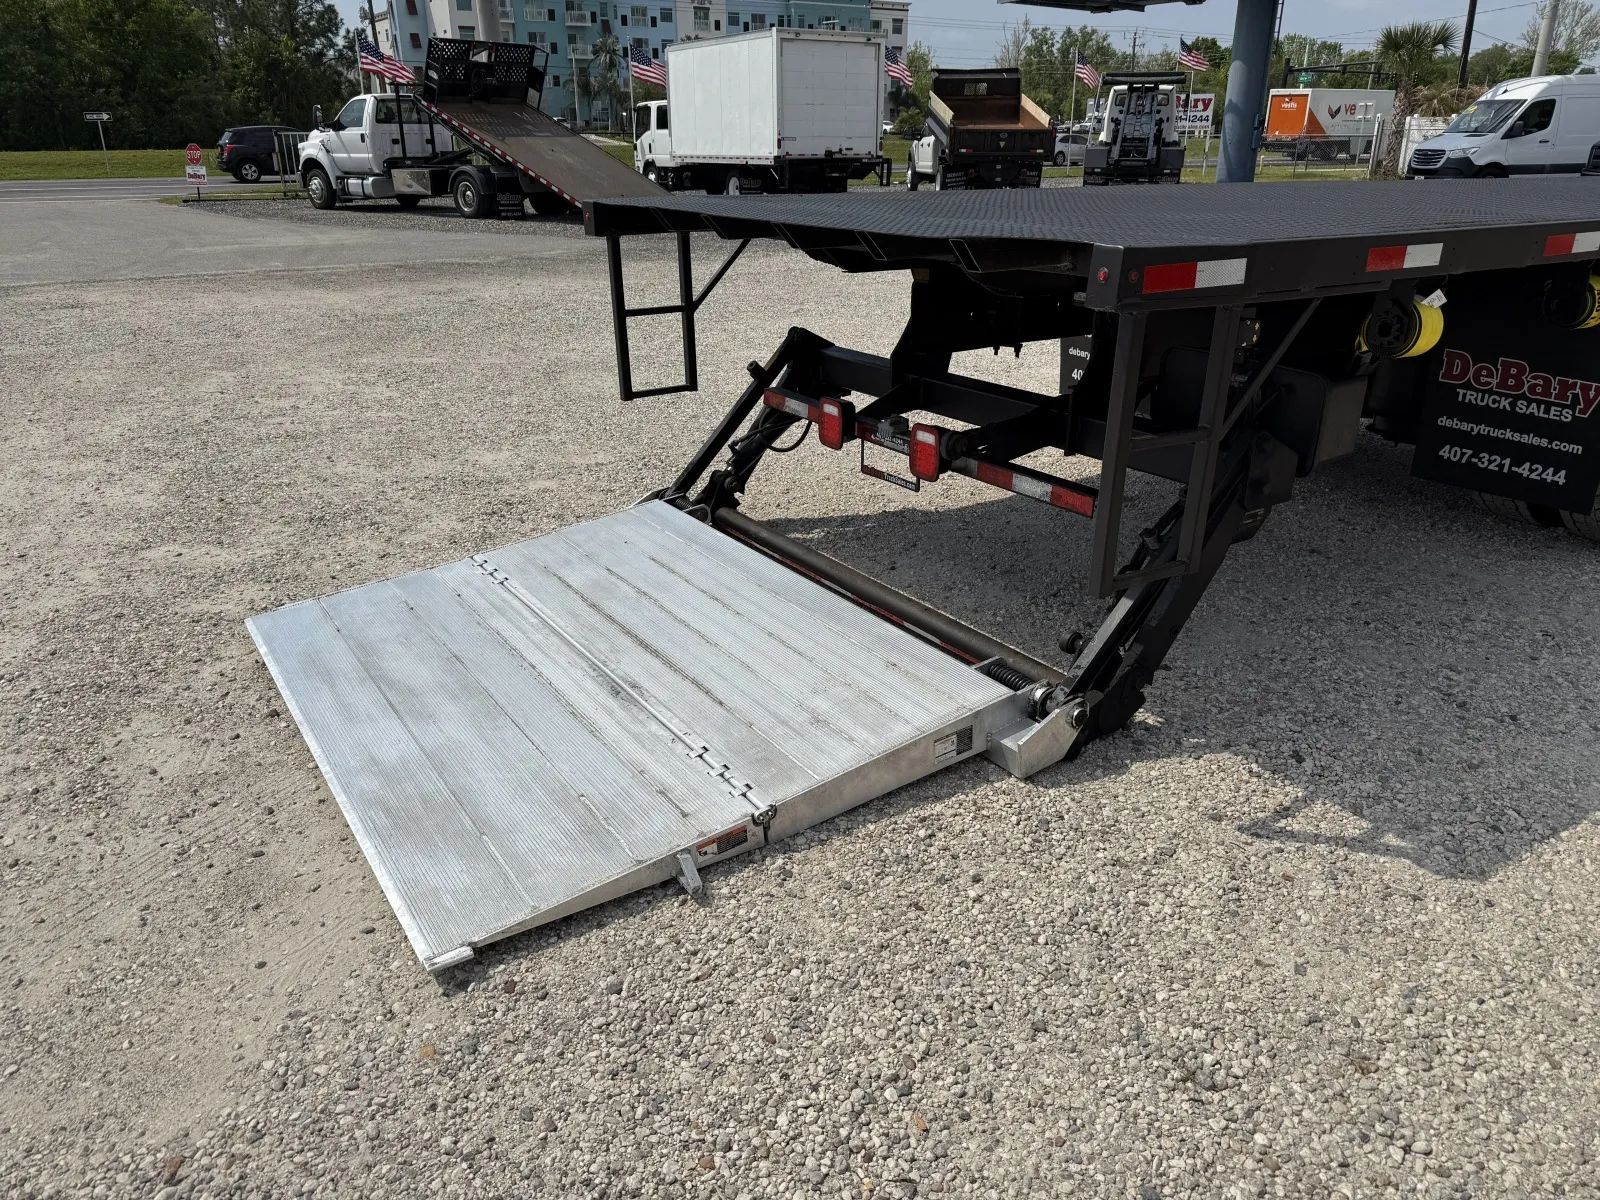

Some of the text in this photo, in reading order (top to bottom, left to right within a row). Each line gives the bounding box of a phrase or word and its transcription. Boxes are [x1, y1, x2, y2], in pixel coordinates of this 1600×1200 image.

[187, 151, 201, 159] STOP
[1438, 348, 1600, 418] DeBary
[1456, 388, 1574, 423] TRUCK SALES
[1437, 416, 1584, 455] debarytrucksales.com
[1438, 444, 1567, 485] 407-321-4244
